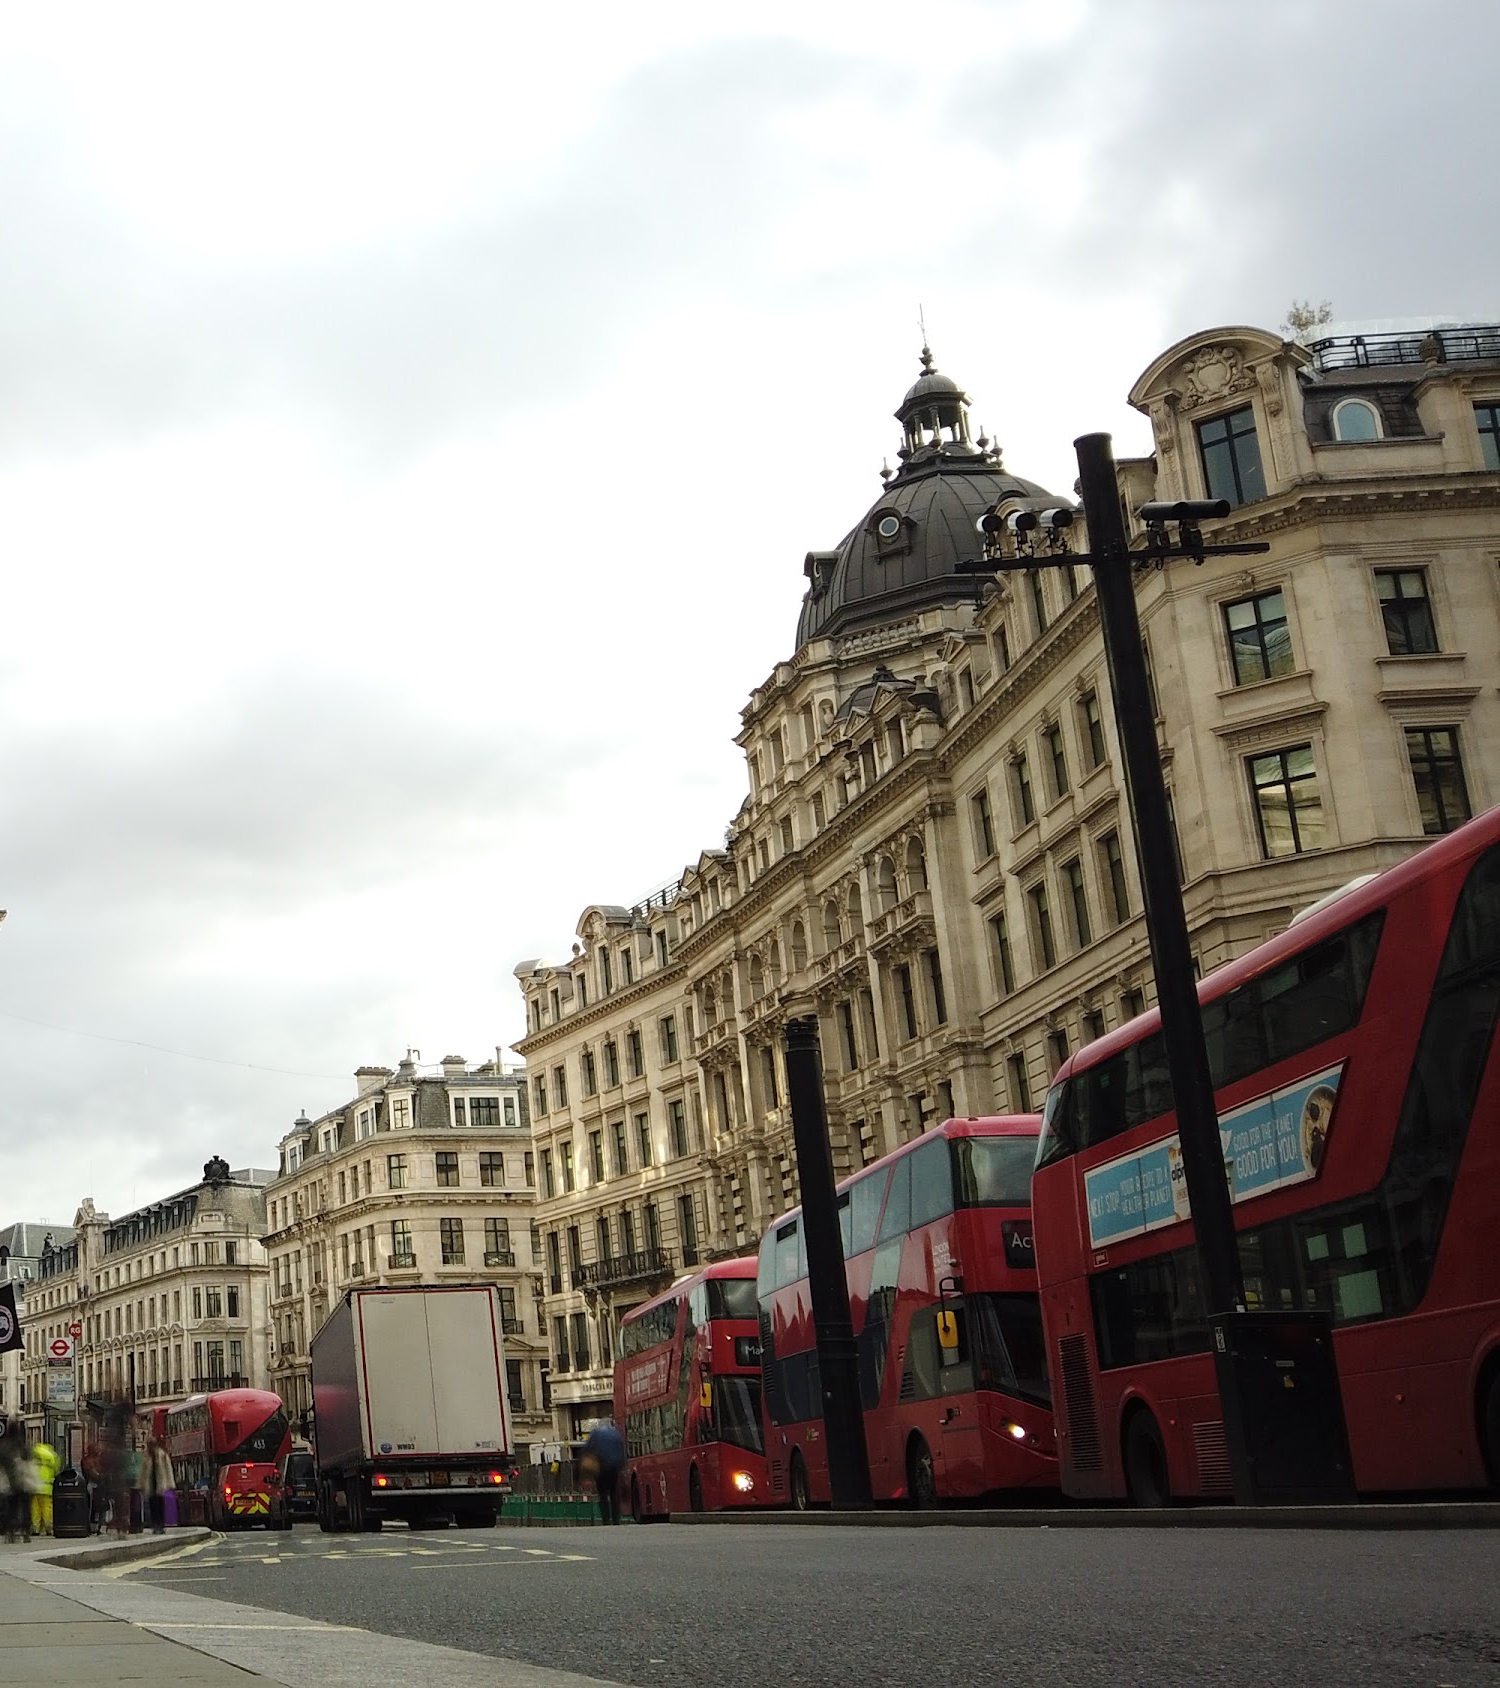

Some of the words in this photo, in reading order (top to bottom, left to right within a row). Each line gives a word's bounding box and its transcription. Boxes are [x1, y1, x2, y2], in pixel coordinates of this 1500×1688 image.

[1273, 1112, 1295, 1137] LANET
[1236, 1150, 1259, 1180] GOOD
[1260, 1142, 1276, 1170] FOR
[1278, 1134, 1298, 1164] YOU!
